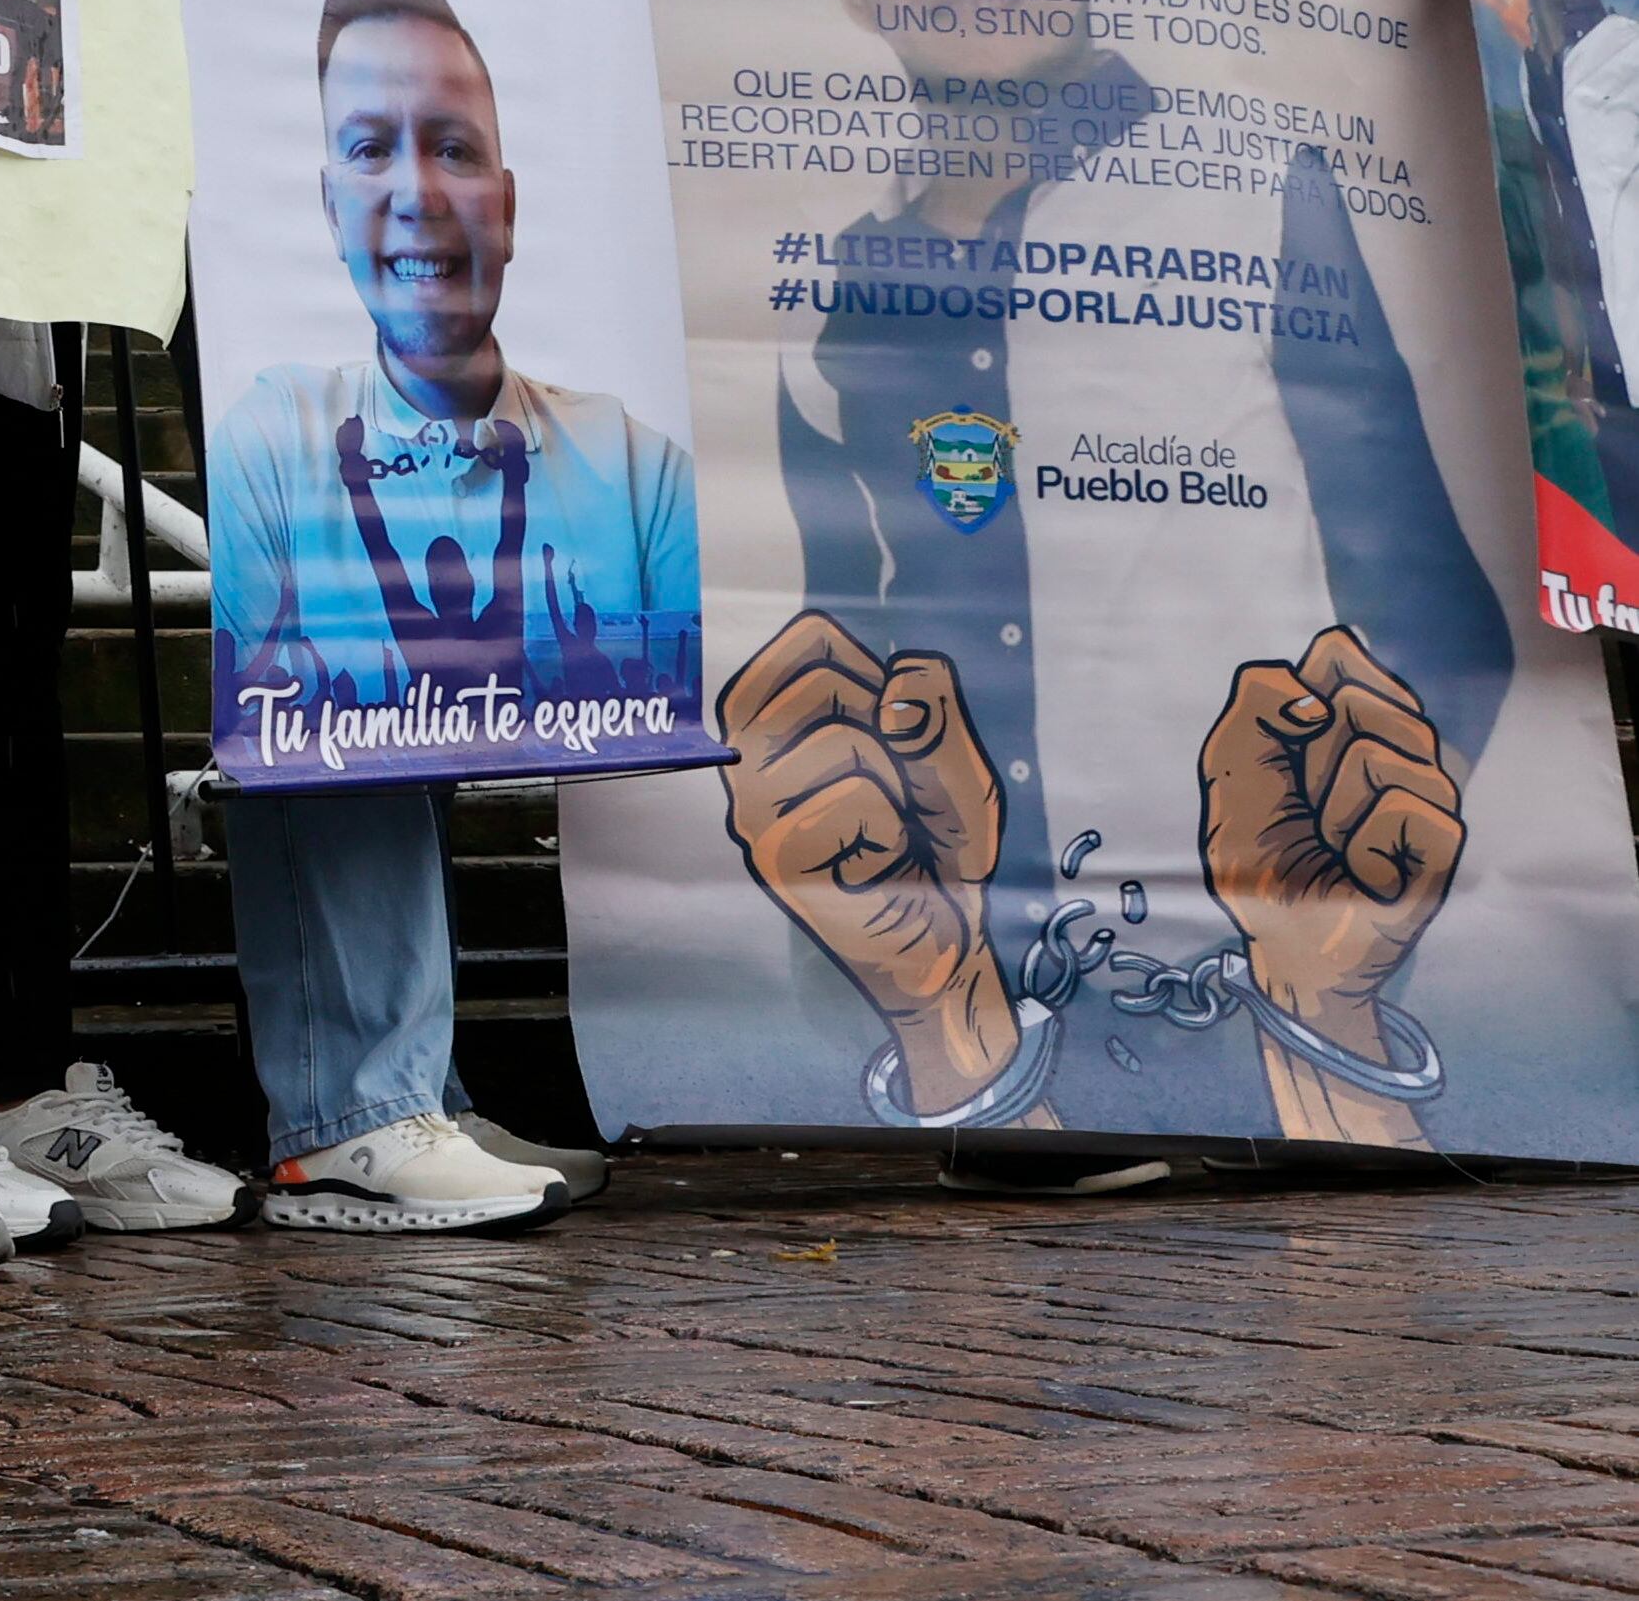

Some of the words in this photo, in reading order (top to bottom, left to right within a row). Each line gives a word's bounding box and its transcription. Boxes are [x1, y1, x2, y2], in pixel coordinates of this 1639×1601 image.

[876, 4, 966, 37] UNO,
[975, 7, 1074, 38] SINO
[1087, 11, 1135, 40] DE
[1144, 14, 1267, 56] TODOS.
[1298, 0, 1372, 38] SOLO
[1378, 18, 1409, 49] DE
[734, 69, 814, 99] QUE
[824, 73, 933, 104] CADA
[945, 78, 1049, 108] PASO
[1061, 82, 1140, 113] QUE
[1150, 86, 1267, 126] DEMOS
[1274, 103, 1330, 137] SEA
[1336, 113, 1375, 146] UN
[681, 104, 1000, 143] RECORDATORIO
[1011, 117, 1059, 145] DE
[1071, 118, 1149, 150] QUE
[1160, 124, 1203, 153] LA
[1213, 128, 1348, 177] JUSTICIA
[1357, 152, 1372, 179] Y
[1379, 158, 1412, 188] LA
[866, 147, 994, 178] DEBEN
[1005, 153, 1241, 193] PREVALECER
[1251, 168, 1323, 203] PARA
[1329, 183, 1433, 225] TODOS.
[773, 232, 1350, 301] #LIBERTADPARABRAYAN
[769, 278, 1360, 347] #UNIDOSPORLAJUSTICIA
[1070, 433, 1192, 468] Alcaldía
[1200, 439, 1237, 469] de
[1035, 465, 1170, 504] Pueblo
[1179, 470, 1269, 510] Bello
[1541, 569, 1590, 632] Tu
[238, 681, 311, 767] Tu
[316, 673, 477, 771] familia
[457, 673, 525, 742] te
[534, 694, 676, 755] espera
